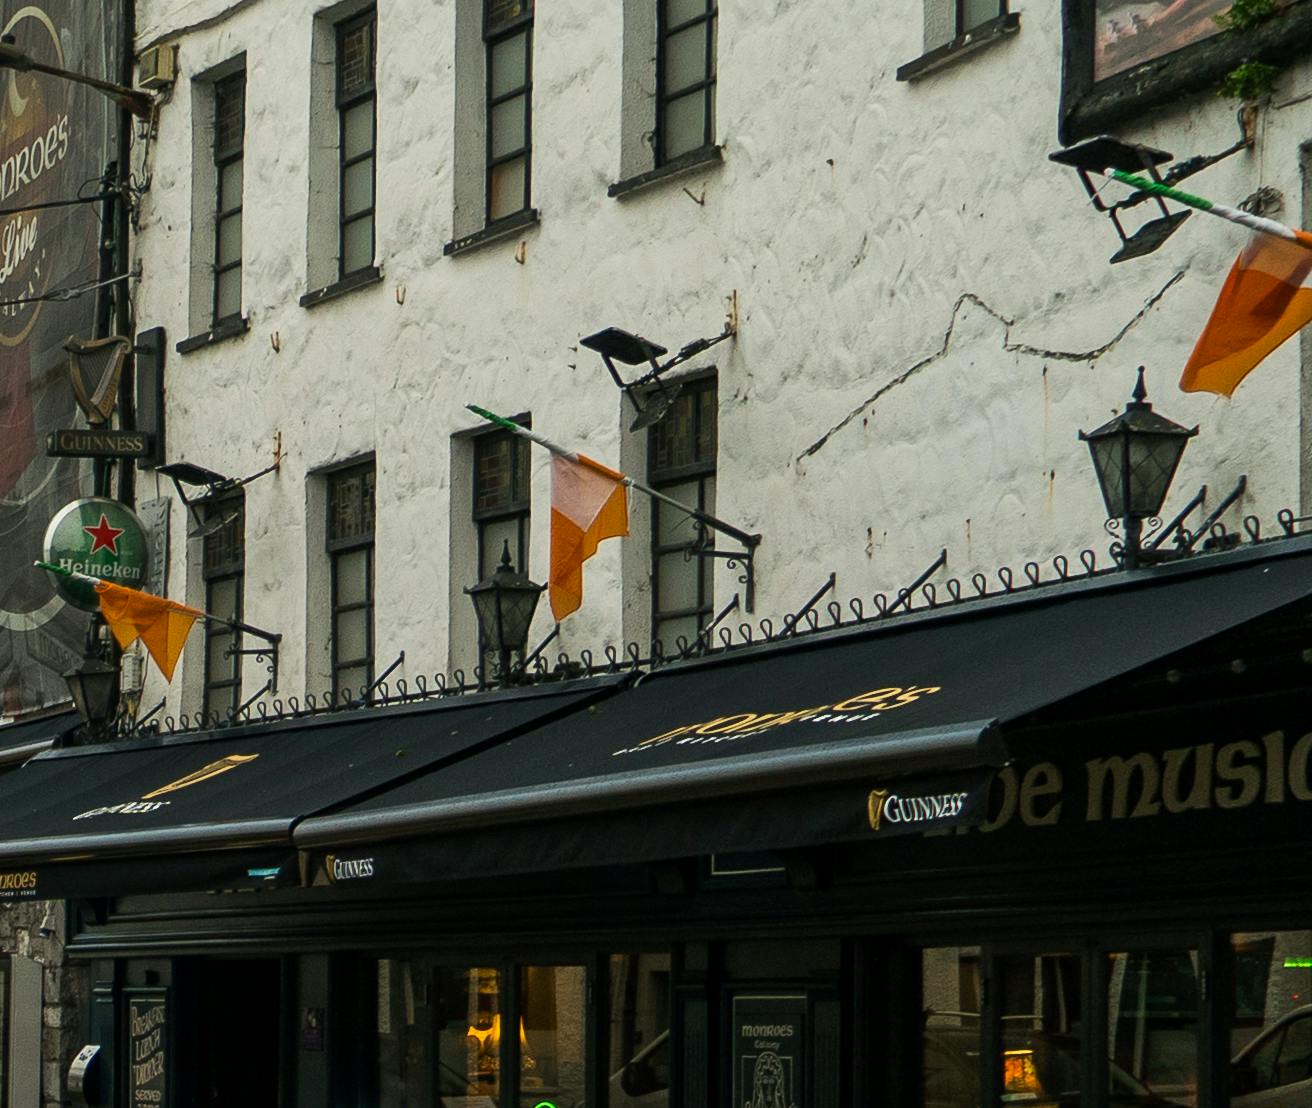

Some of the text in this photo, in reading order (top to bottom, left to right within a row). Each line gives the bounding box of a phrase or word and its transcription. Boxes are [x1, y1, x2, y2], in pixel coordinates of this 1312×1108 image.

[0, 216, 38, 284] Live
[60, 432, 144, 450] GUINNESS
[59, 559, 141, 579] Heineken
[883, 792, 968, 824] GUINNESS
[334, 858, 374, 879] GUINNESS
